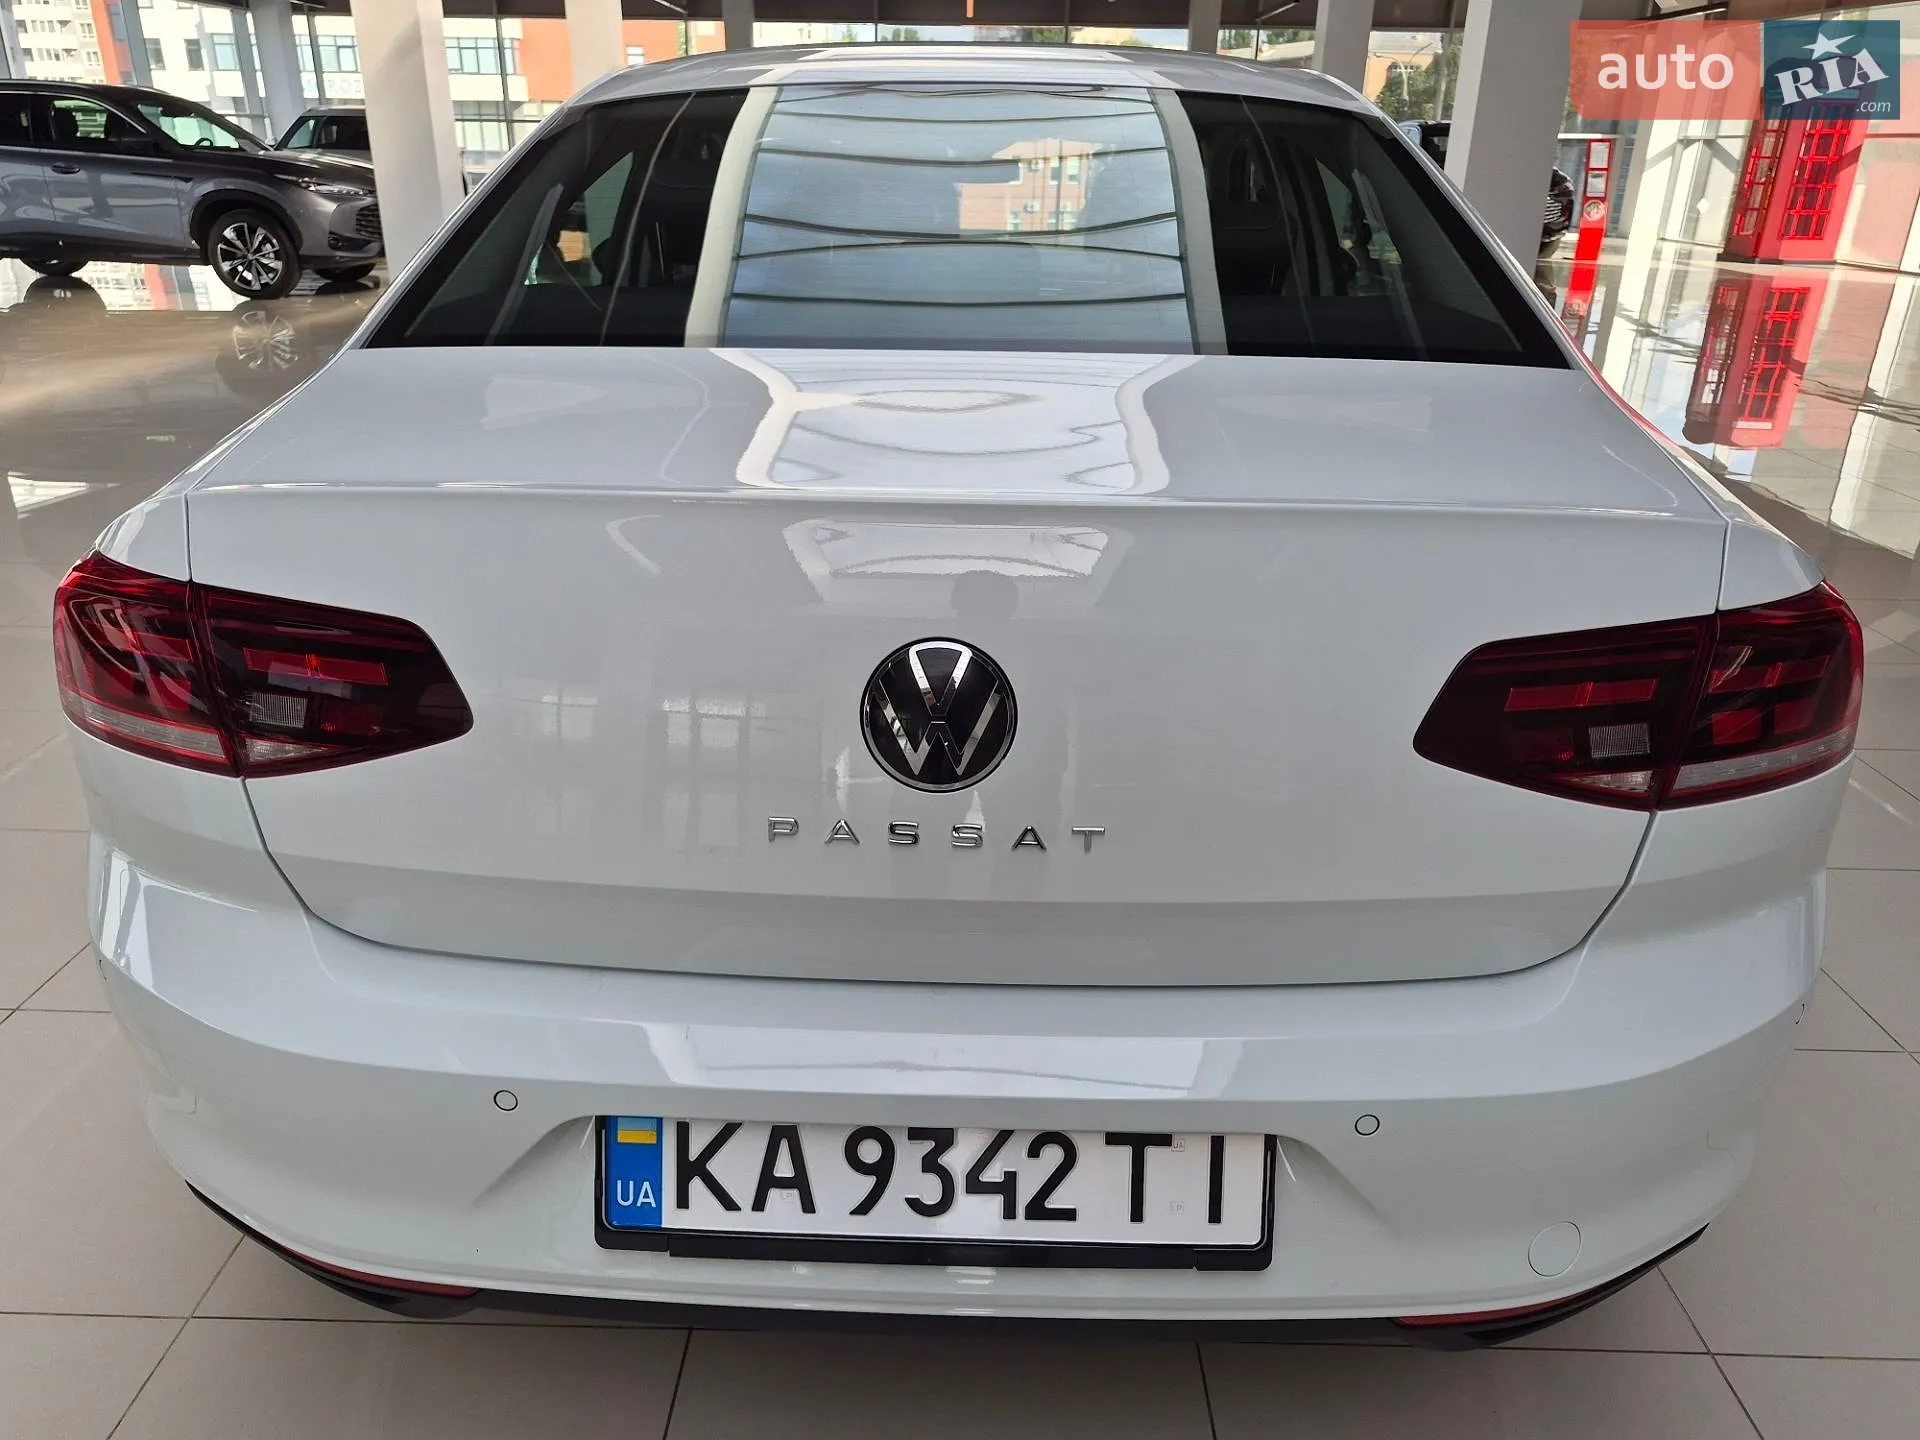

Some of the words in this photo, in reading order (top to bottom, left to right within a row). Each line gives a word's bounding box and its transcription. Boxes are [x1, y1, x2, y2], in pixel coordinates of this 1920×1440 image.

[768, 816, 1106, 852] PASSAT
[676, 1120, 816, 1214] KA
[844, 1125, 1077, 1221] 9342
[616, 1180, 657, 1208] UA
